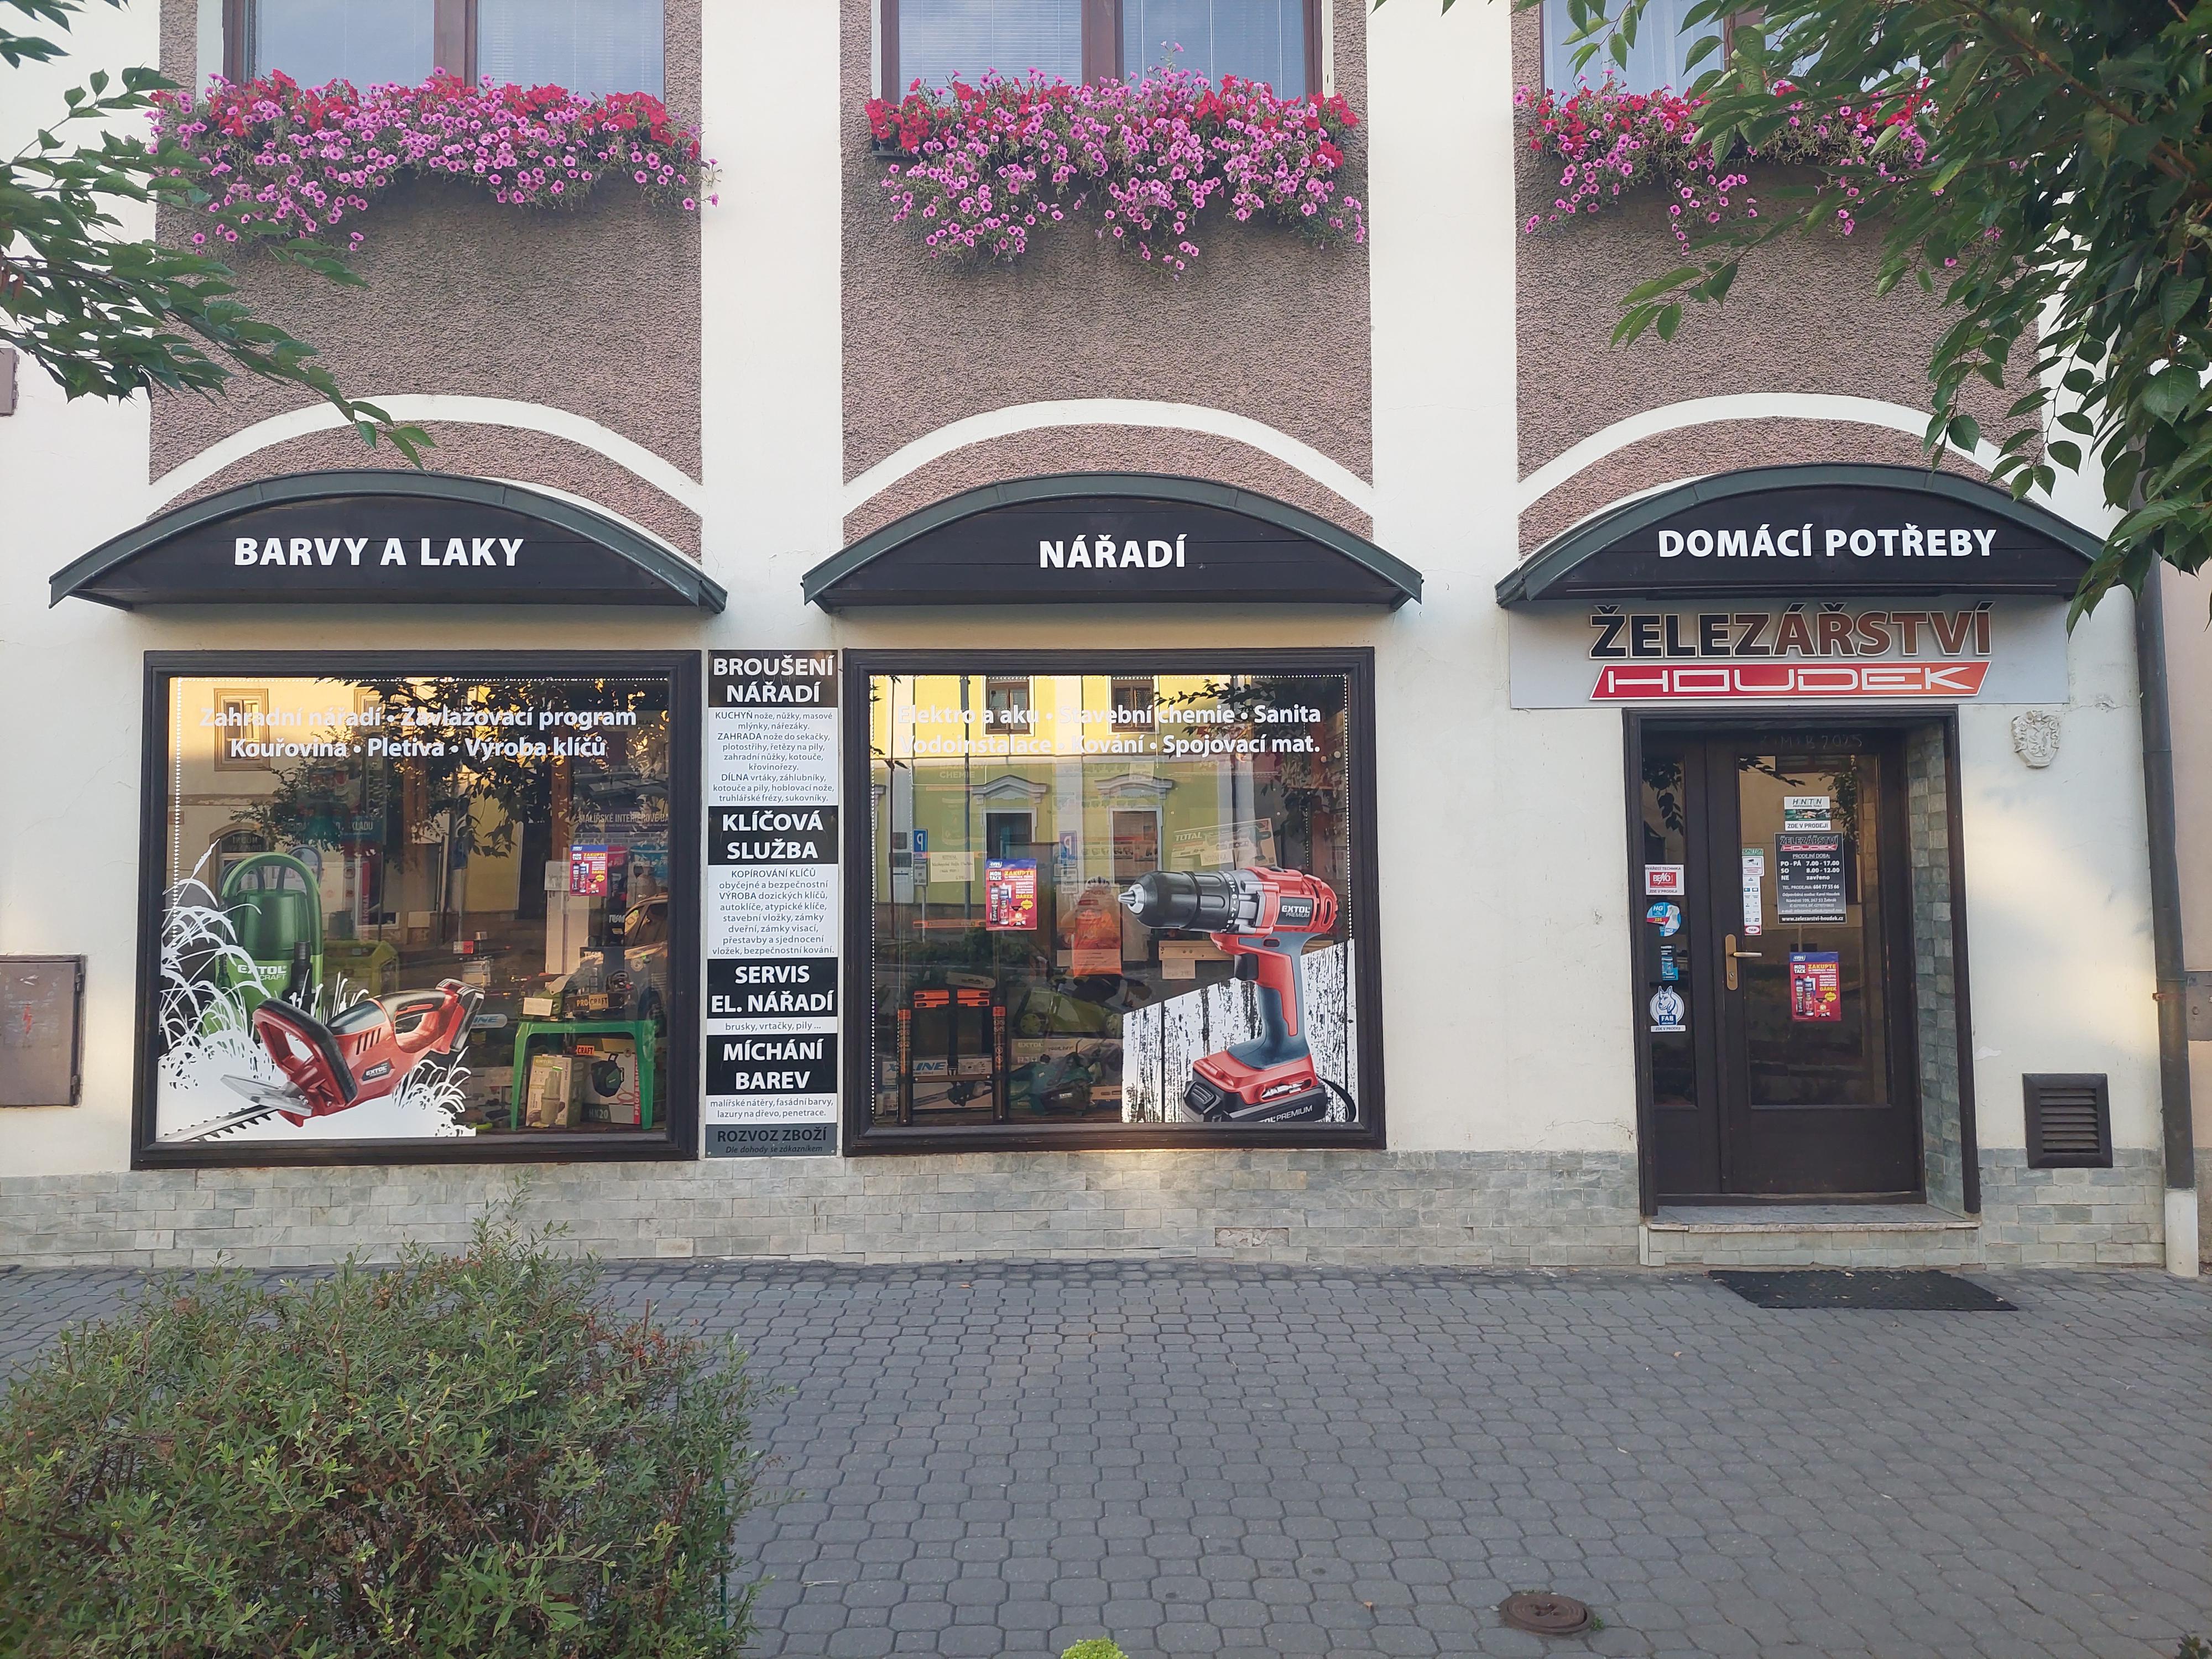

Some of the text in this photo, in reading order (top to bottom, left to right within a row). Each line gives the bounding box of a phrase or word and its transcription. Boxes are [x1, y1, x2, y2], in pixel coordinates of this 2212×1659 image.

[1658, 523, 1997, 558] DOMÁCÍ POTŘEBY
[234, 538, 524, 566] BARVY A LAKY
[1039, 534, 1187, 568] NÁŘADÍ
[1589, 601, 1996, 659] ŽELEZÁŘSTVÍ
[713, 655, 833, 676] BROUŠENÍ
[1608, 667, 1975, 693] HOUDEK
[727, 681, 821, 702] NÁŘADÍ
[200, 704, 636, 730] Zahradní nářadí Zavlažovací program
[716, 711, 753, 719] KUCHYŇ
[776, 712, 801, 721] nůžky,
[898, 704, 1321, 724] Elektro a aku Stavební chemie Sanita
[738, 722, 810, 731] mlýnky, nářezáky.
[796, 733, 830, 742] sekačky,
[231, 735, 605, 761] Kouřovina Pletiva Výroba klíčů
[723, 743, 769, 752] plotostřihy,
[770, 743, 795, 752] řetězy
[808, 743, 825, 752] pily,
[899, 734, 1321, 758] Vodoinstalace Kování Spojovací mat.
[761, 753, 787, 762] nůžky,
[789, 753, 823, 761] kotouče,
[749, 763, 799, 772] křovinořezy.
[721, 772, 826, 782] DÍLNA vrtáky, záhlubníky,
[753, 784, 770, 792] pily,
[762, 794, 784, 802] frézy,
[785, 794, 828, 802] sukovníky.
[722, 810, 823, 831] KLÍČOVÁ
[1780, 835, 1838, 844] ŽELEZÁŘSTVÍ
[727, 838, 818, 859] SLUŽBA
[732, 867, 816, 878] KOPÍROVÁNÍ KLÍČŮ
[719, 881, 760, 891] obyčejné
[768, 880, 828, 890] bezpečnostní
[719, 891, 828, 901] VÝROBA dozických klíčů,
[720, 902, 827, 912] autoklíče, atypické klíče,
[723, 914, 824, 923] stavební vložky, zámky
[728, 924, 818, 934] dveřní, zámky visací,
[723, 936, 767, 945] přestavby
[775, 935, 824, 945] sjednocení
[713, 946, 834, 956] vložek, bezpečnostní kování.
[735, 965, 810, 984] SERVIS
[711, 990, 834, 1013] EL. NÁŘADÍ
[726, 1022, 757, 1031] brusky,
[759, 1022, 794, 1031] vrtačky,
[723, 1039, 825, 1061] MÍCHÁNÍ
[735, 1071, 810, 1090] BAREV
[711, 1098, 833, 1108] malířské nátěry, fasádní barvy,
[717, 1110, 743, 1119] lazury
[756, 1109, 781, 1118] dřevo,
[782, 1109, 826, 1119] penetrace.
[1276, 1105, 1312, 1121] PREMIUM
[717, 1126, 827, 1142] ROZVOZ ZBOŽÍ
[740, 1145, 768, 1154] dohody
